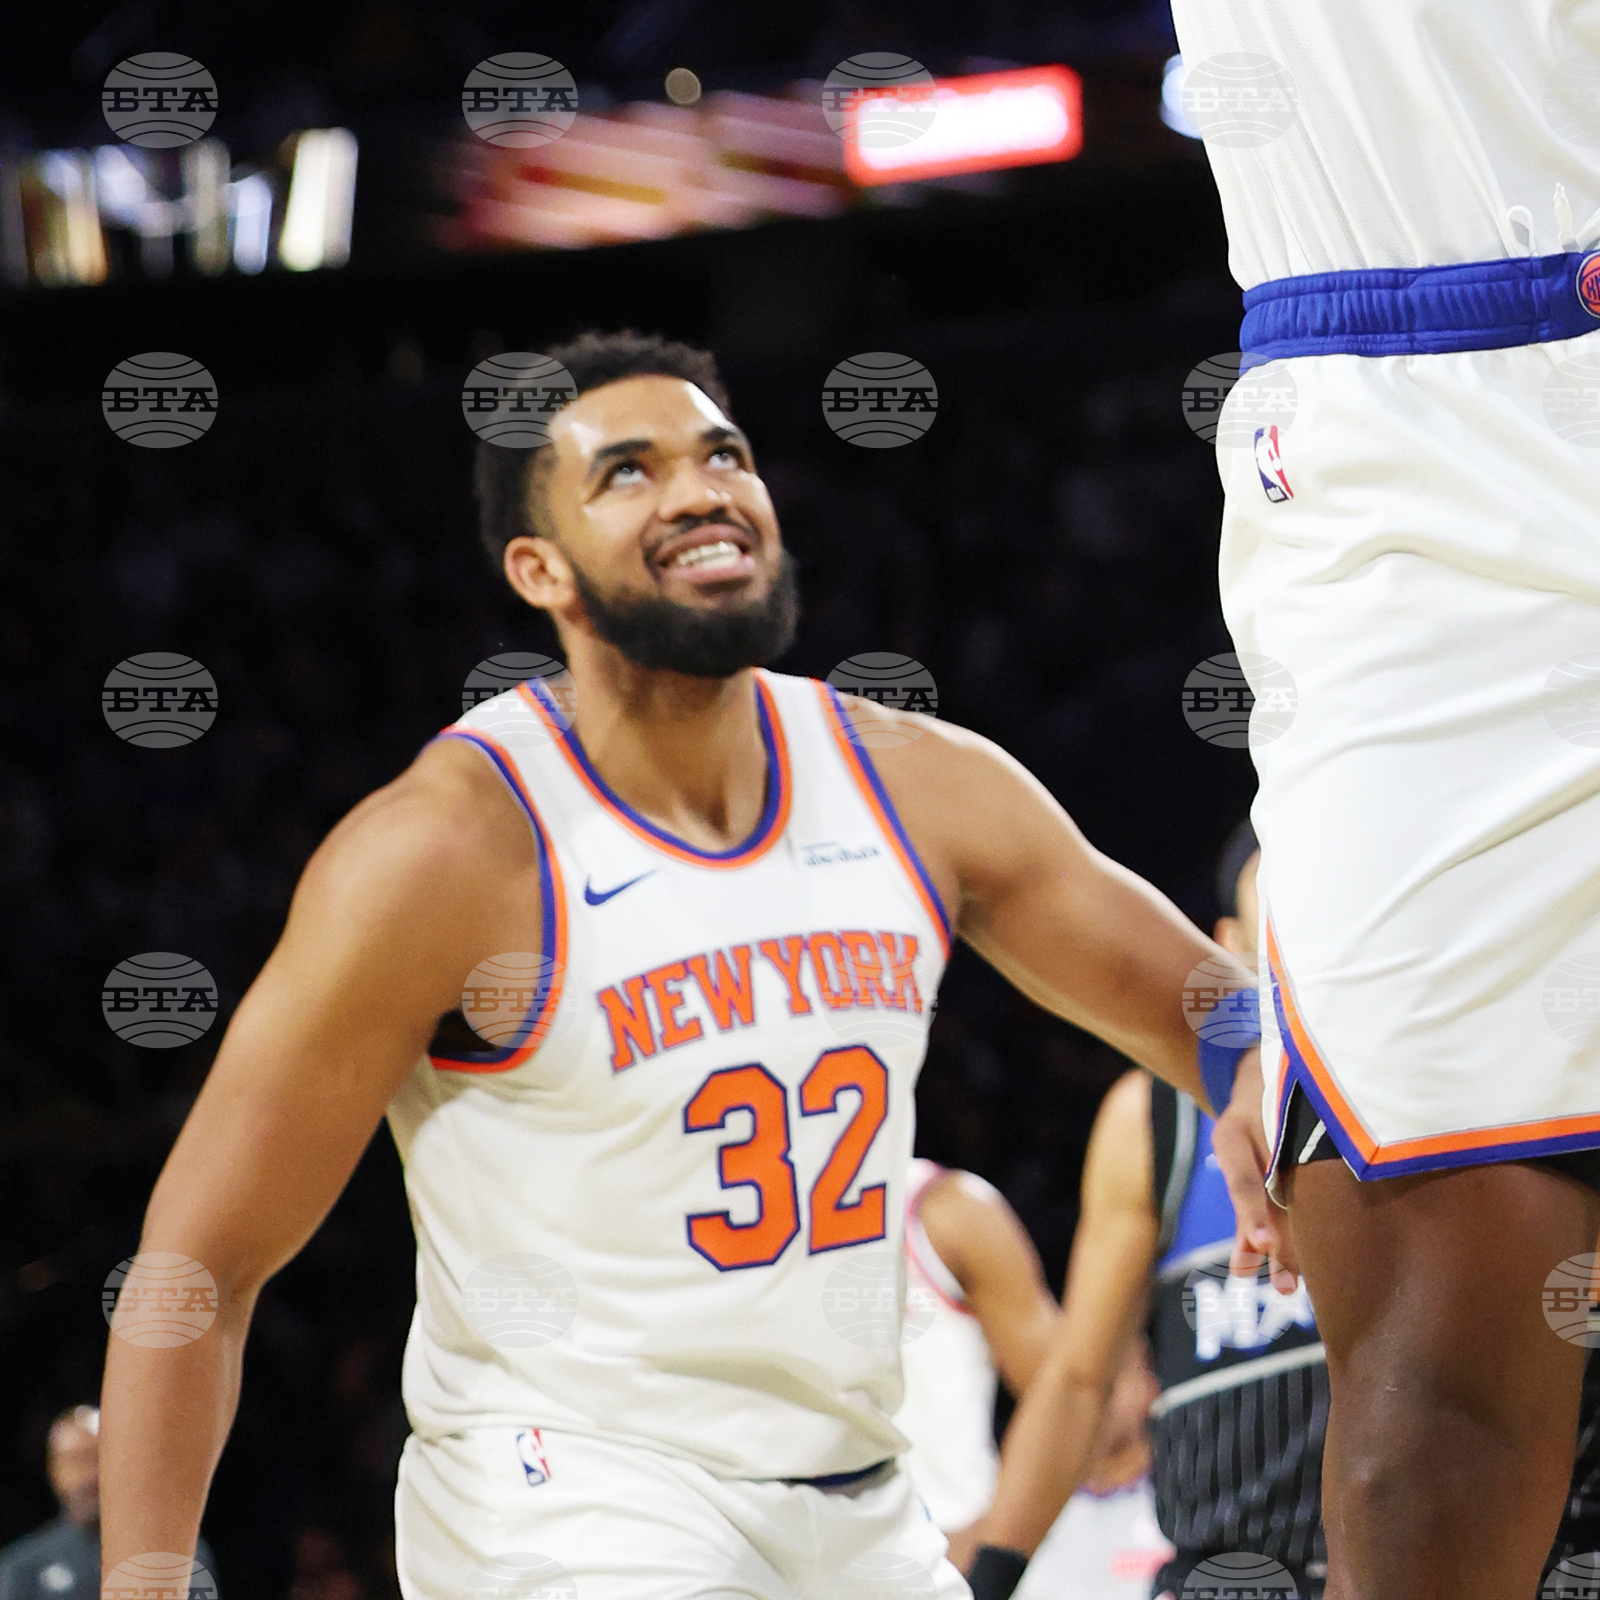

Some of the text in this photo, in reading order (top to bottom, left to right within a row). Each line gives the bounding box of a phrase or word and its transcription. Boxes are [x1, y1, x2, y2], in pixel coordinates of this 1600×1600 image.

[598, 929, 925, 1074] NEW YORK
[684, 1043, 889, 1273] 32
